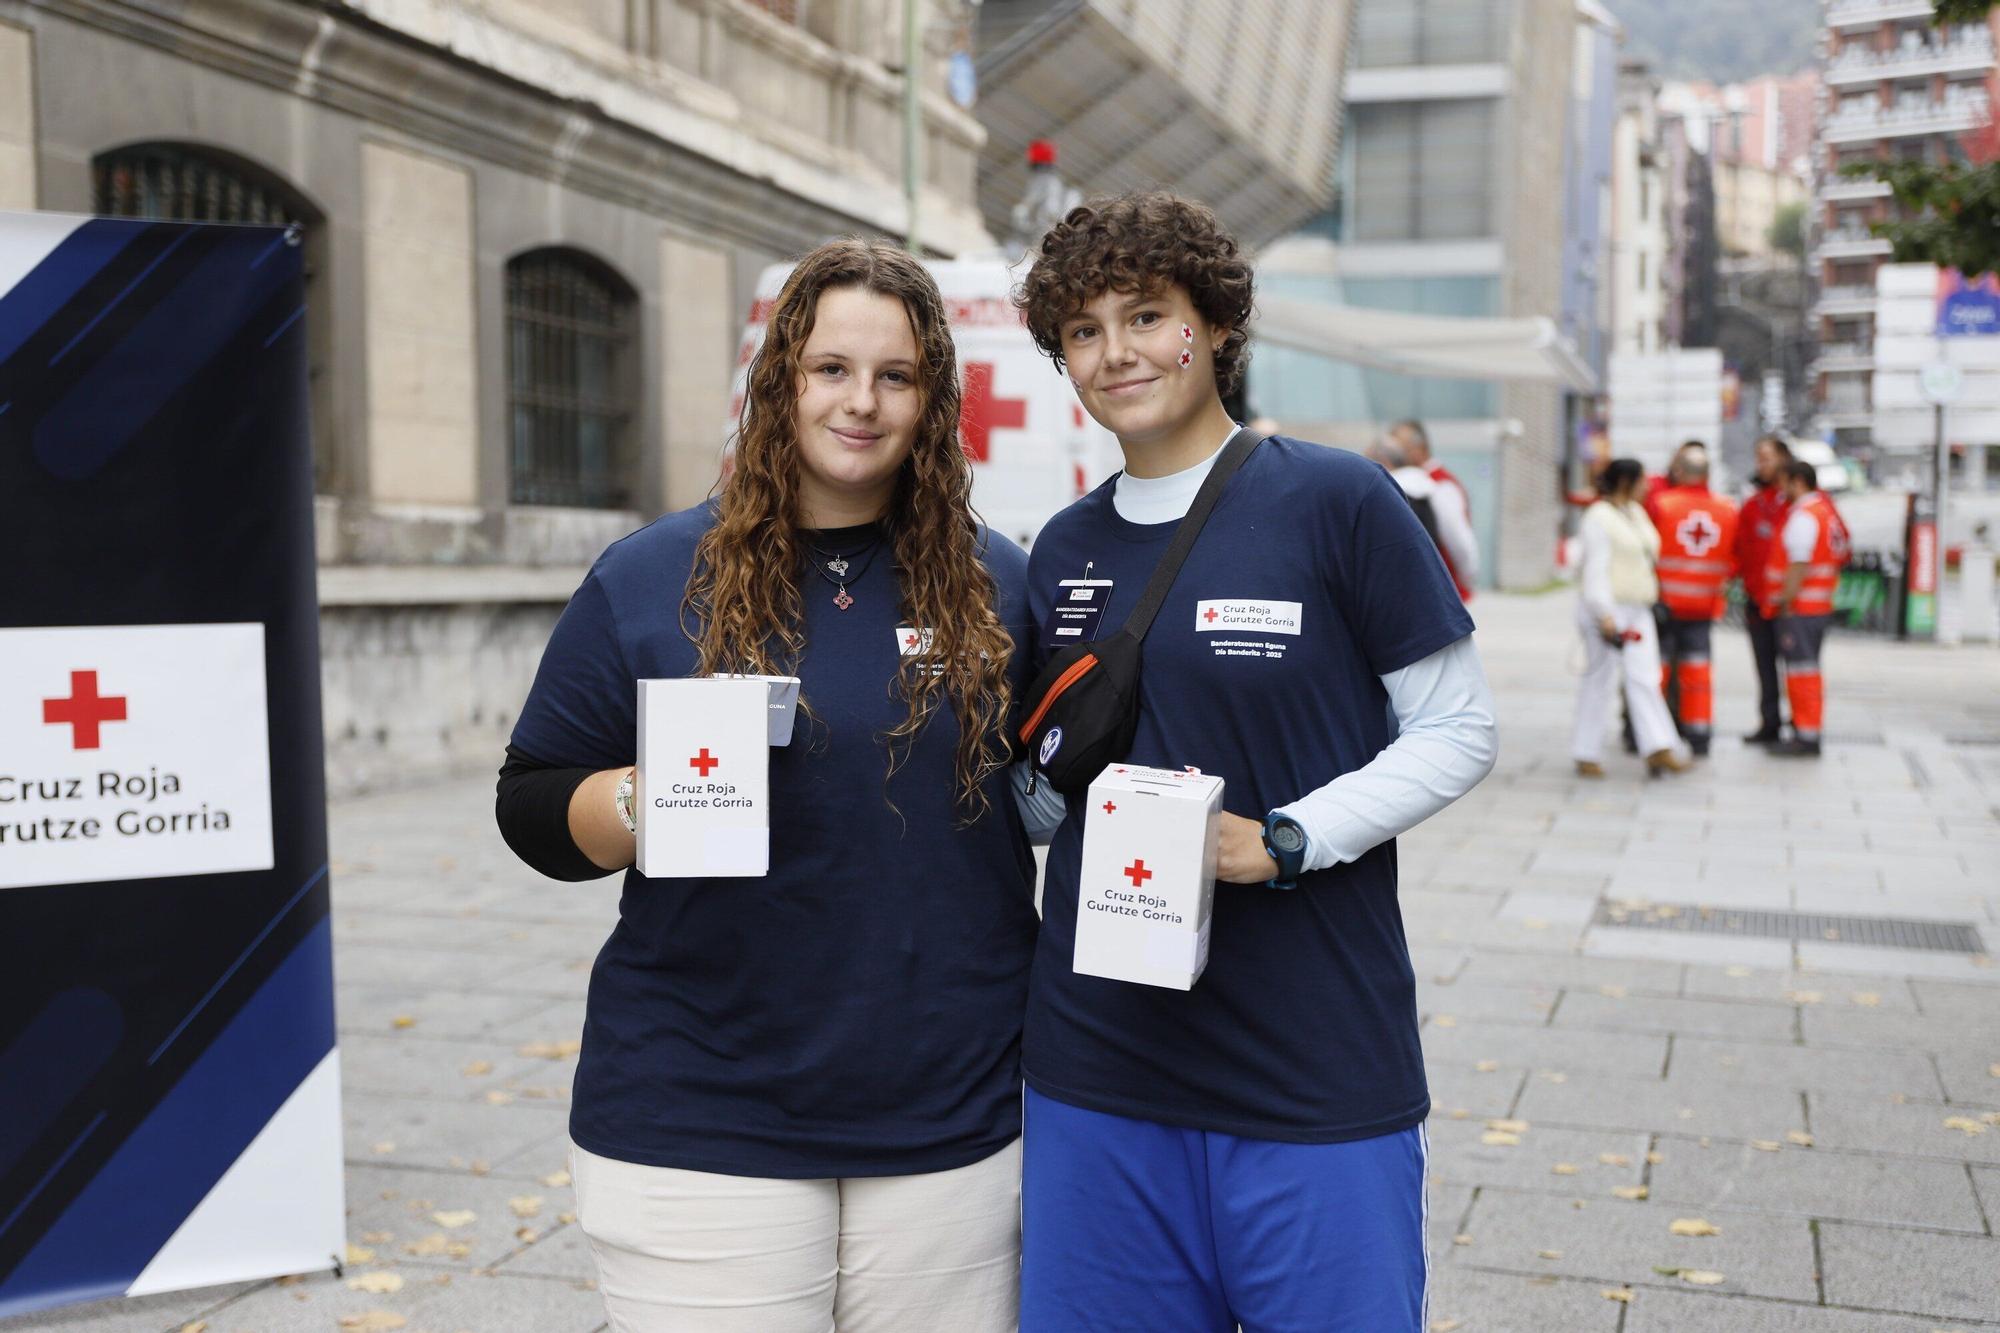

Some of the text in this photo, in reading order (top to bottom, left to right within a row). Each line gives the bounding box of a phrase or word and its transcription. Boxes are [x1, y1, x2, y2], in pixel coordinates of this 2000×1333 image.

[1223, 605, 1271, 616] Cruz Roja
[1222, 615, 1263, 625] Gurutze
[1210, 640, 1287, 651] Banderatxoaren Eguna
[1227, 649, 1261, 657] Banderita
[1265, 651, 1283, 659] 2025
[98, 766, 181, 803] Roja
[672, 782, 736, 796] Cruz Roja
[655, 797, 753, 808] Gurutze Gorria
[0, 803, 231, 845] rutze Gorria
[1104, 889, 1167, 909] Cruz Roja
[1086, 900, 1182, 924] Gurutze Gorria
